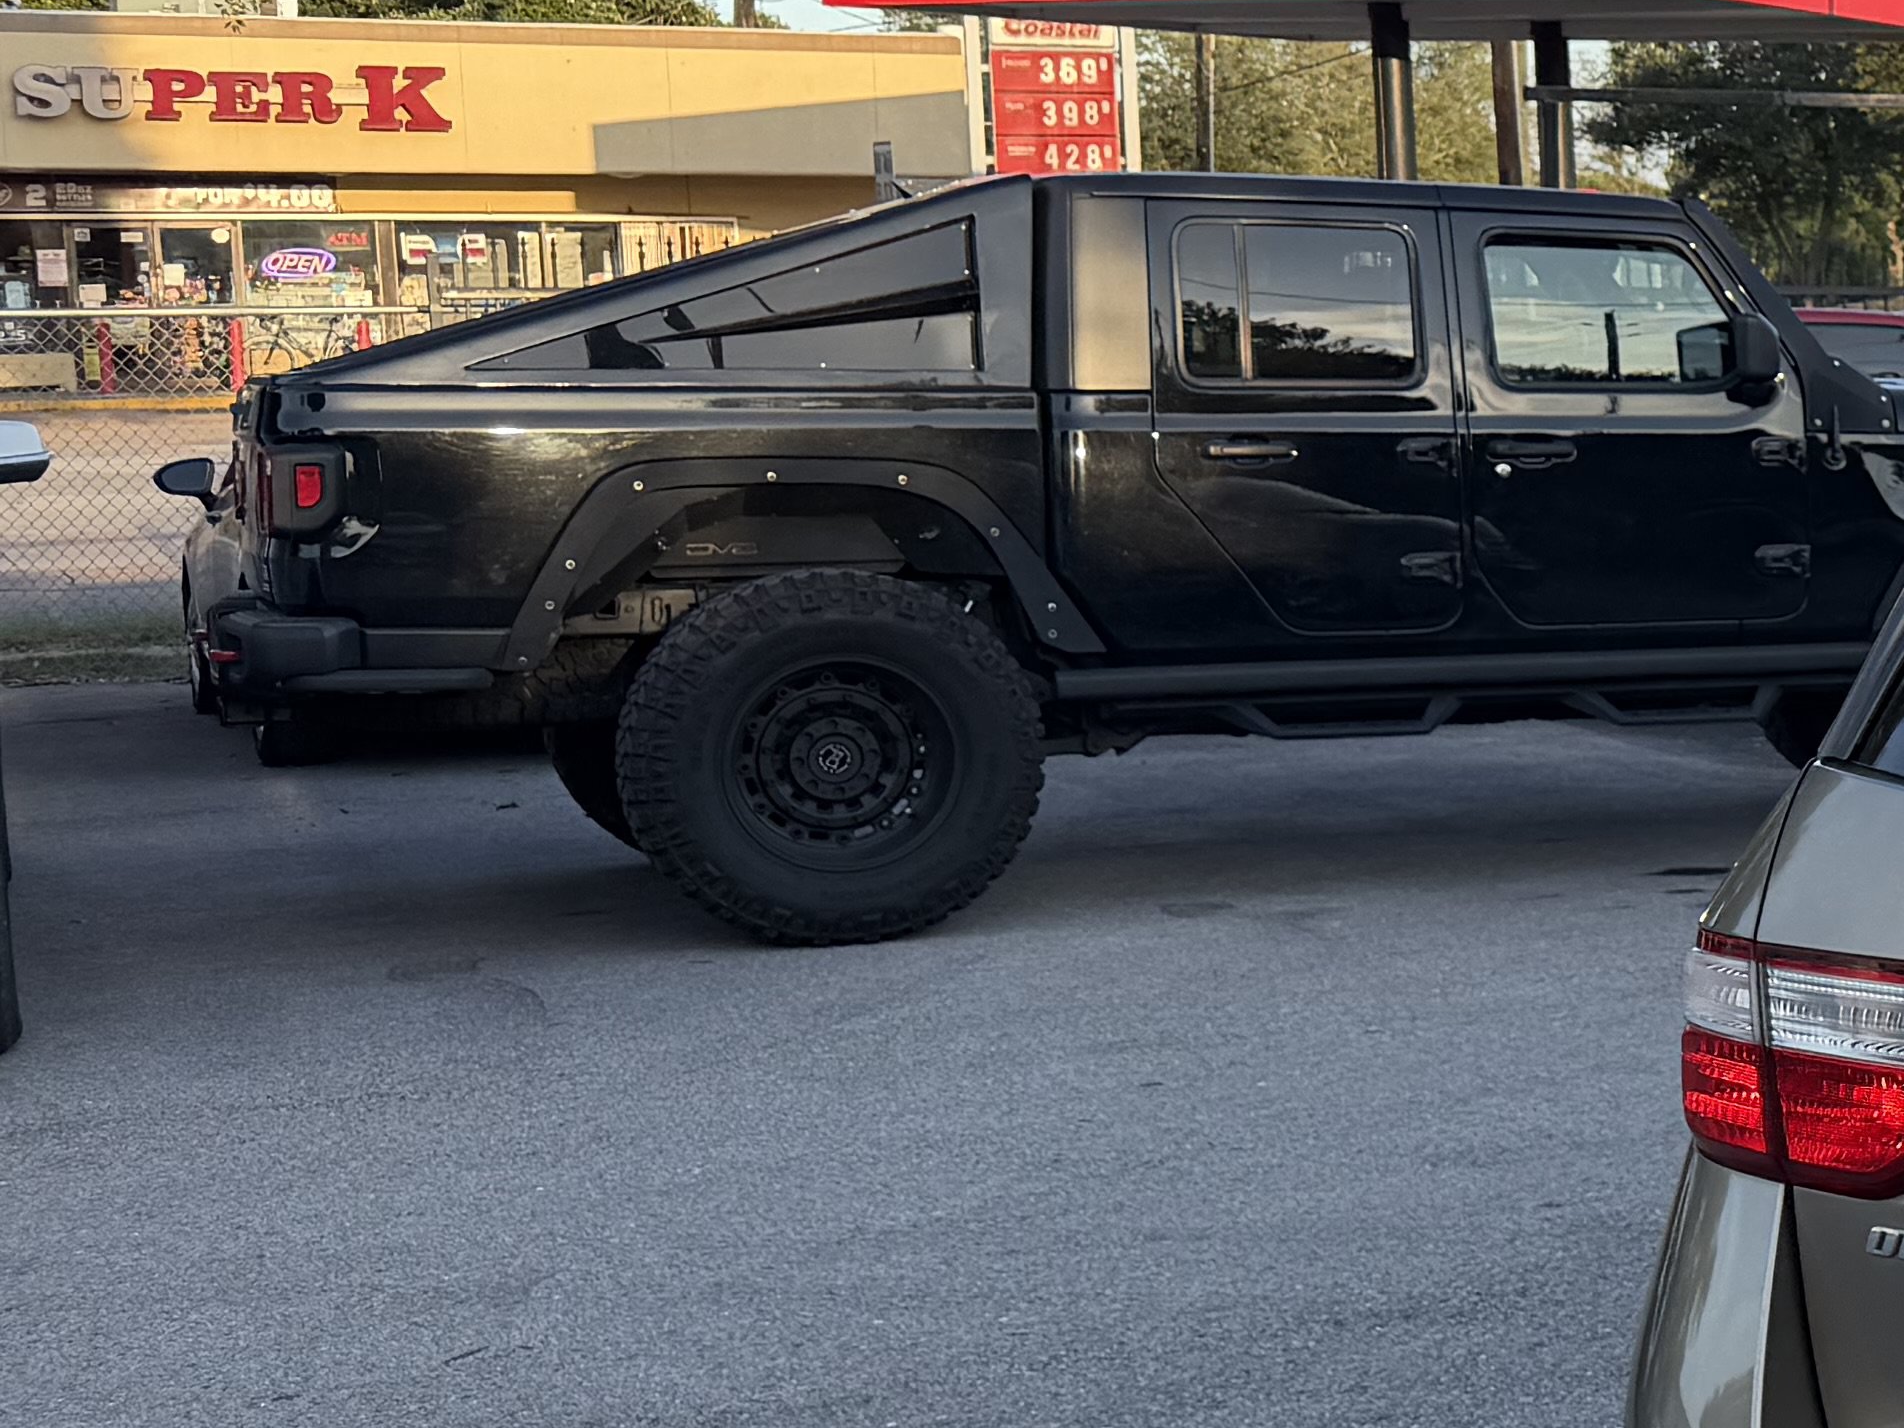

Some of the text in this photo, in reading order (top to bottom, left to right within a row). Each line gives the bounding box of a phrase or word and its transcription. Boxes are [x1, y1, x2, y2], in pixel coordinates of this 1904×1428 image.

[13, 63, 453, 133] SUPER K
[268, 253, 327, 274] OPEN
